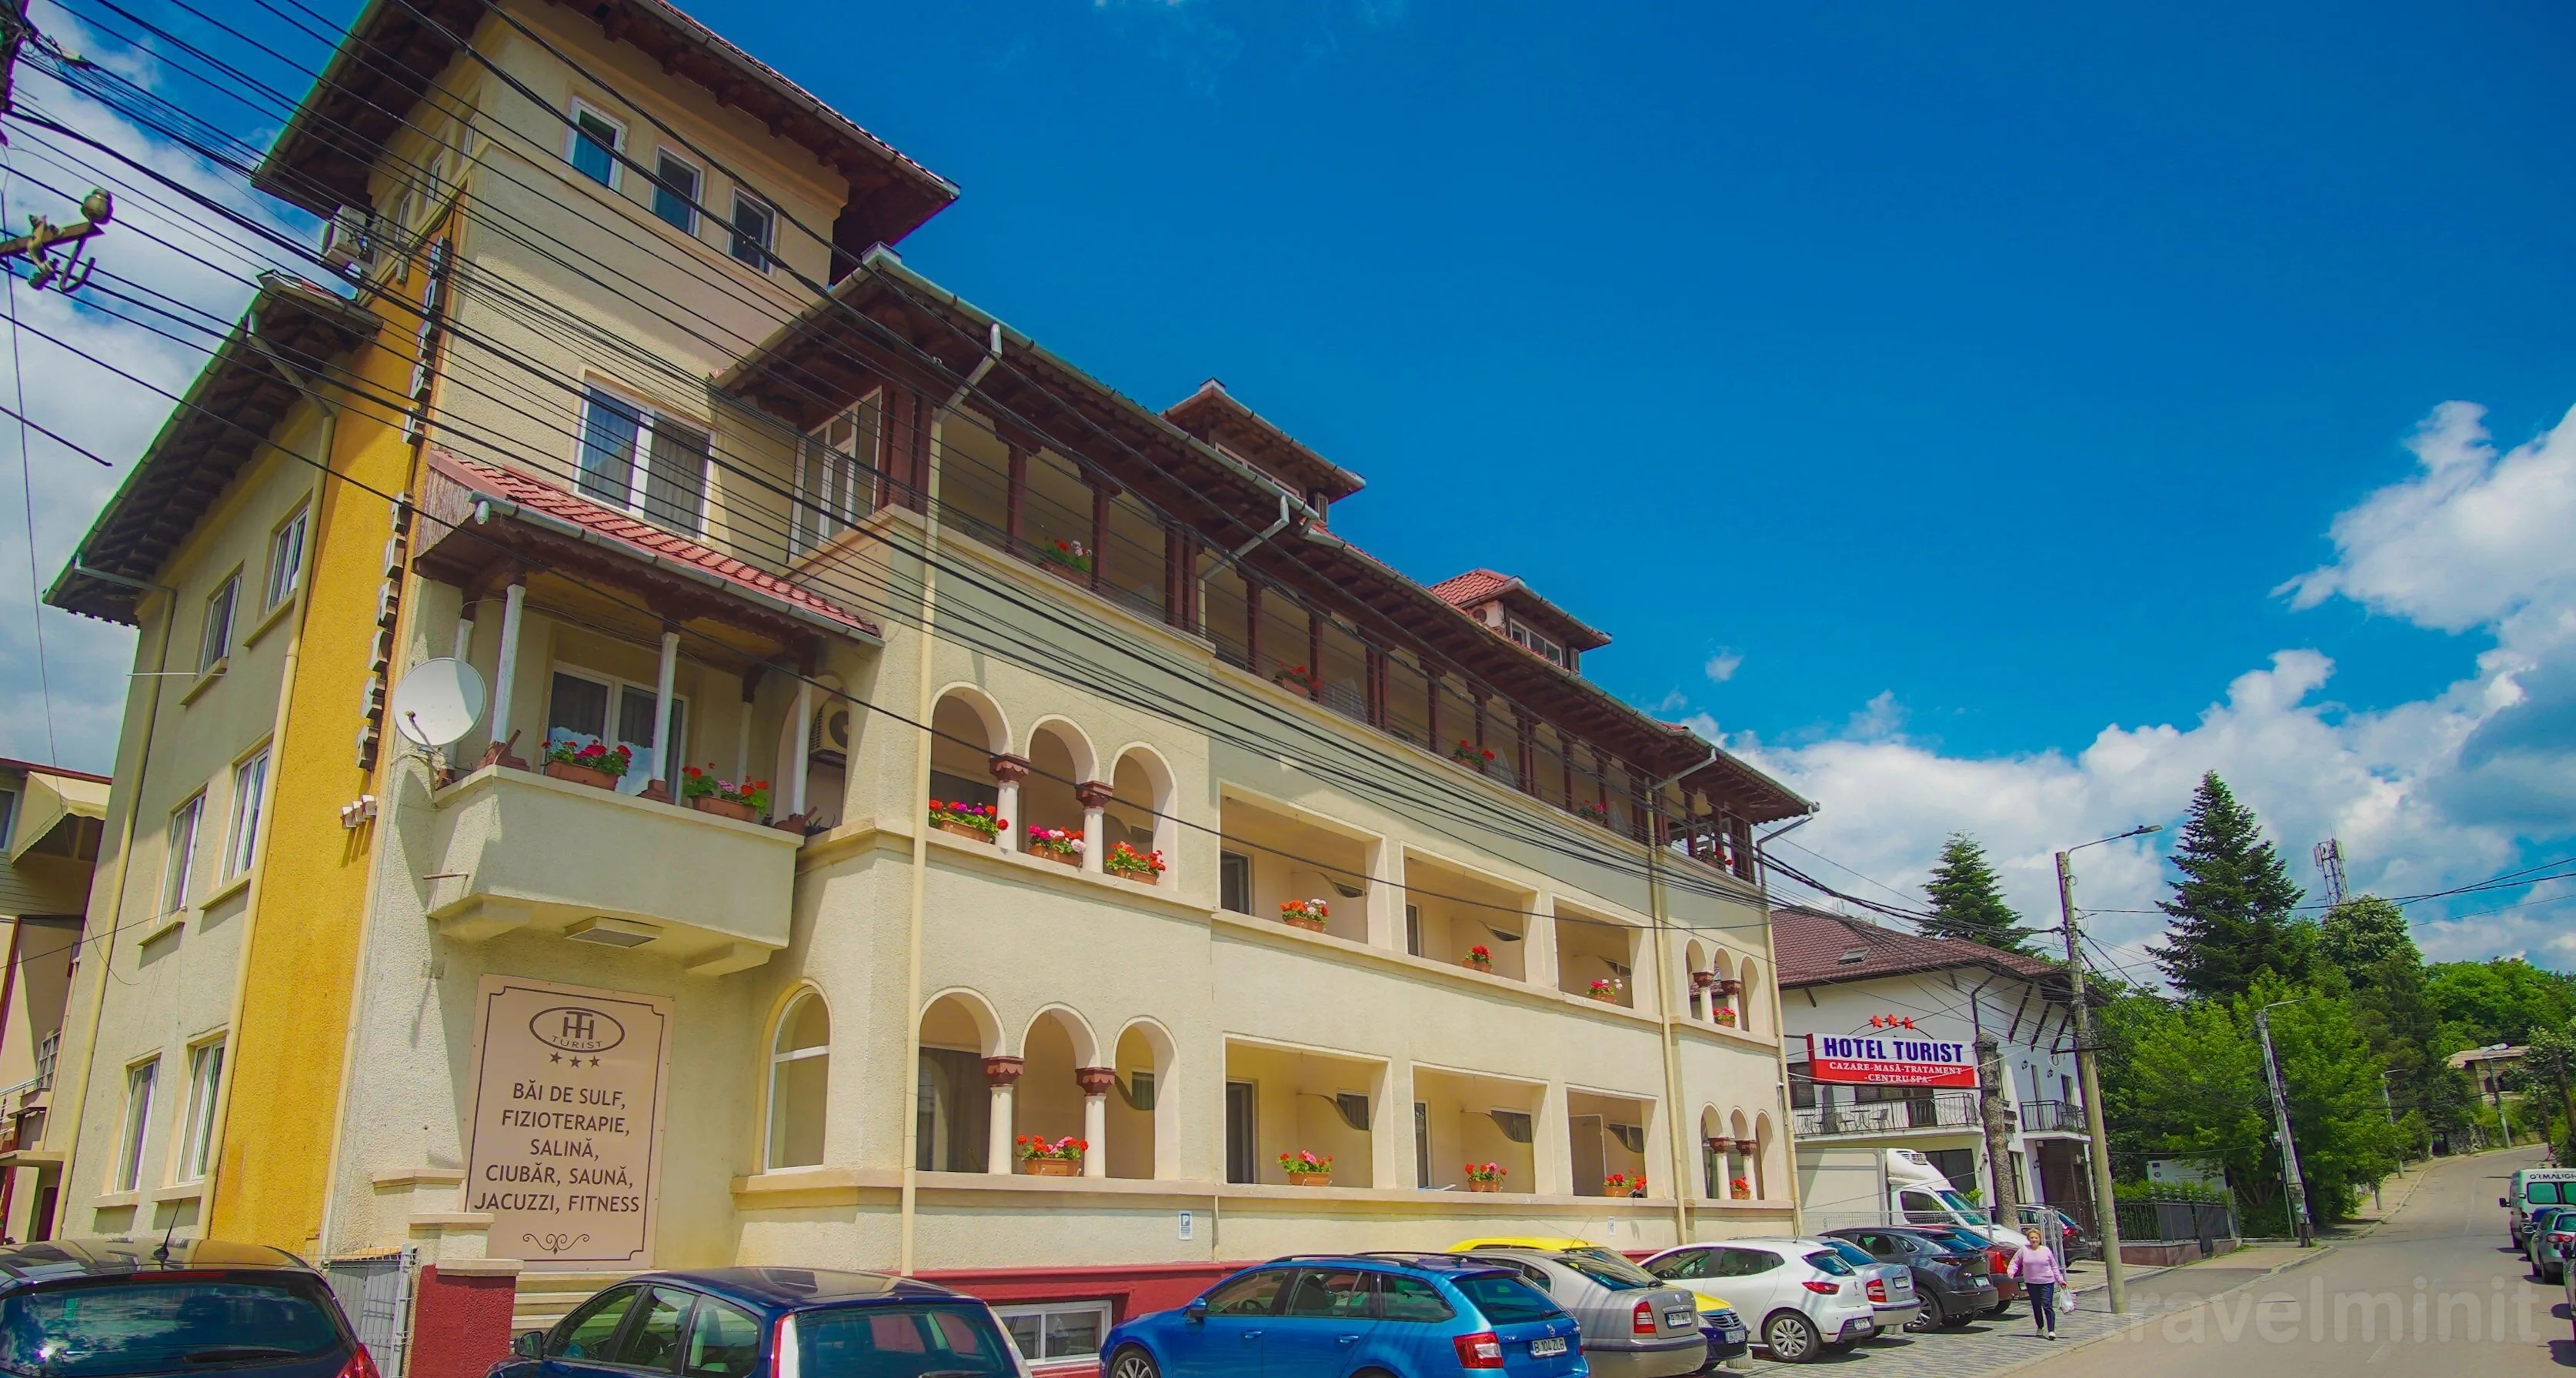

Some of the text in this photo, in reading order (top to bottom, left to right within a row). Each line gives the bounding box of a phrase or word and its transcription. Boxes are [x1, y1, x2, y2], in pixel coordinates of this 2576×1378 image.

[552, 1034, 603, 1049] TURIST
[1824, 1037, 1964, 1063] HOTEL TURIST
[512, 1079, 626, 1110] BĂI DE SULF,
[502, 1109, 630, 1136] FIZIOTERAPIE,
[530, 1137, 599, 1160] SALINĂ,
[486, 1162, 633, 1189] CIUBĂR, SAUNĂ,
[474, 1193, 639, 1214] JACUZZI, FITNESS
